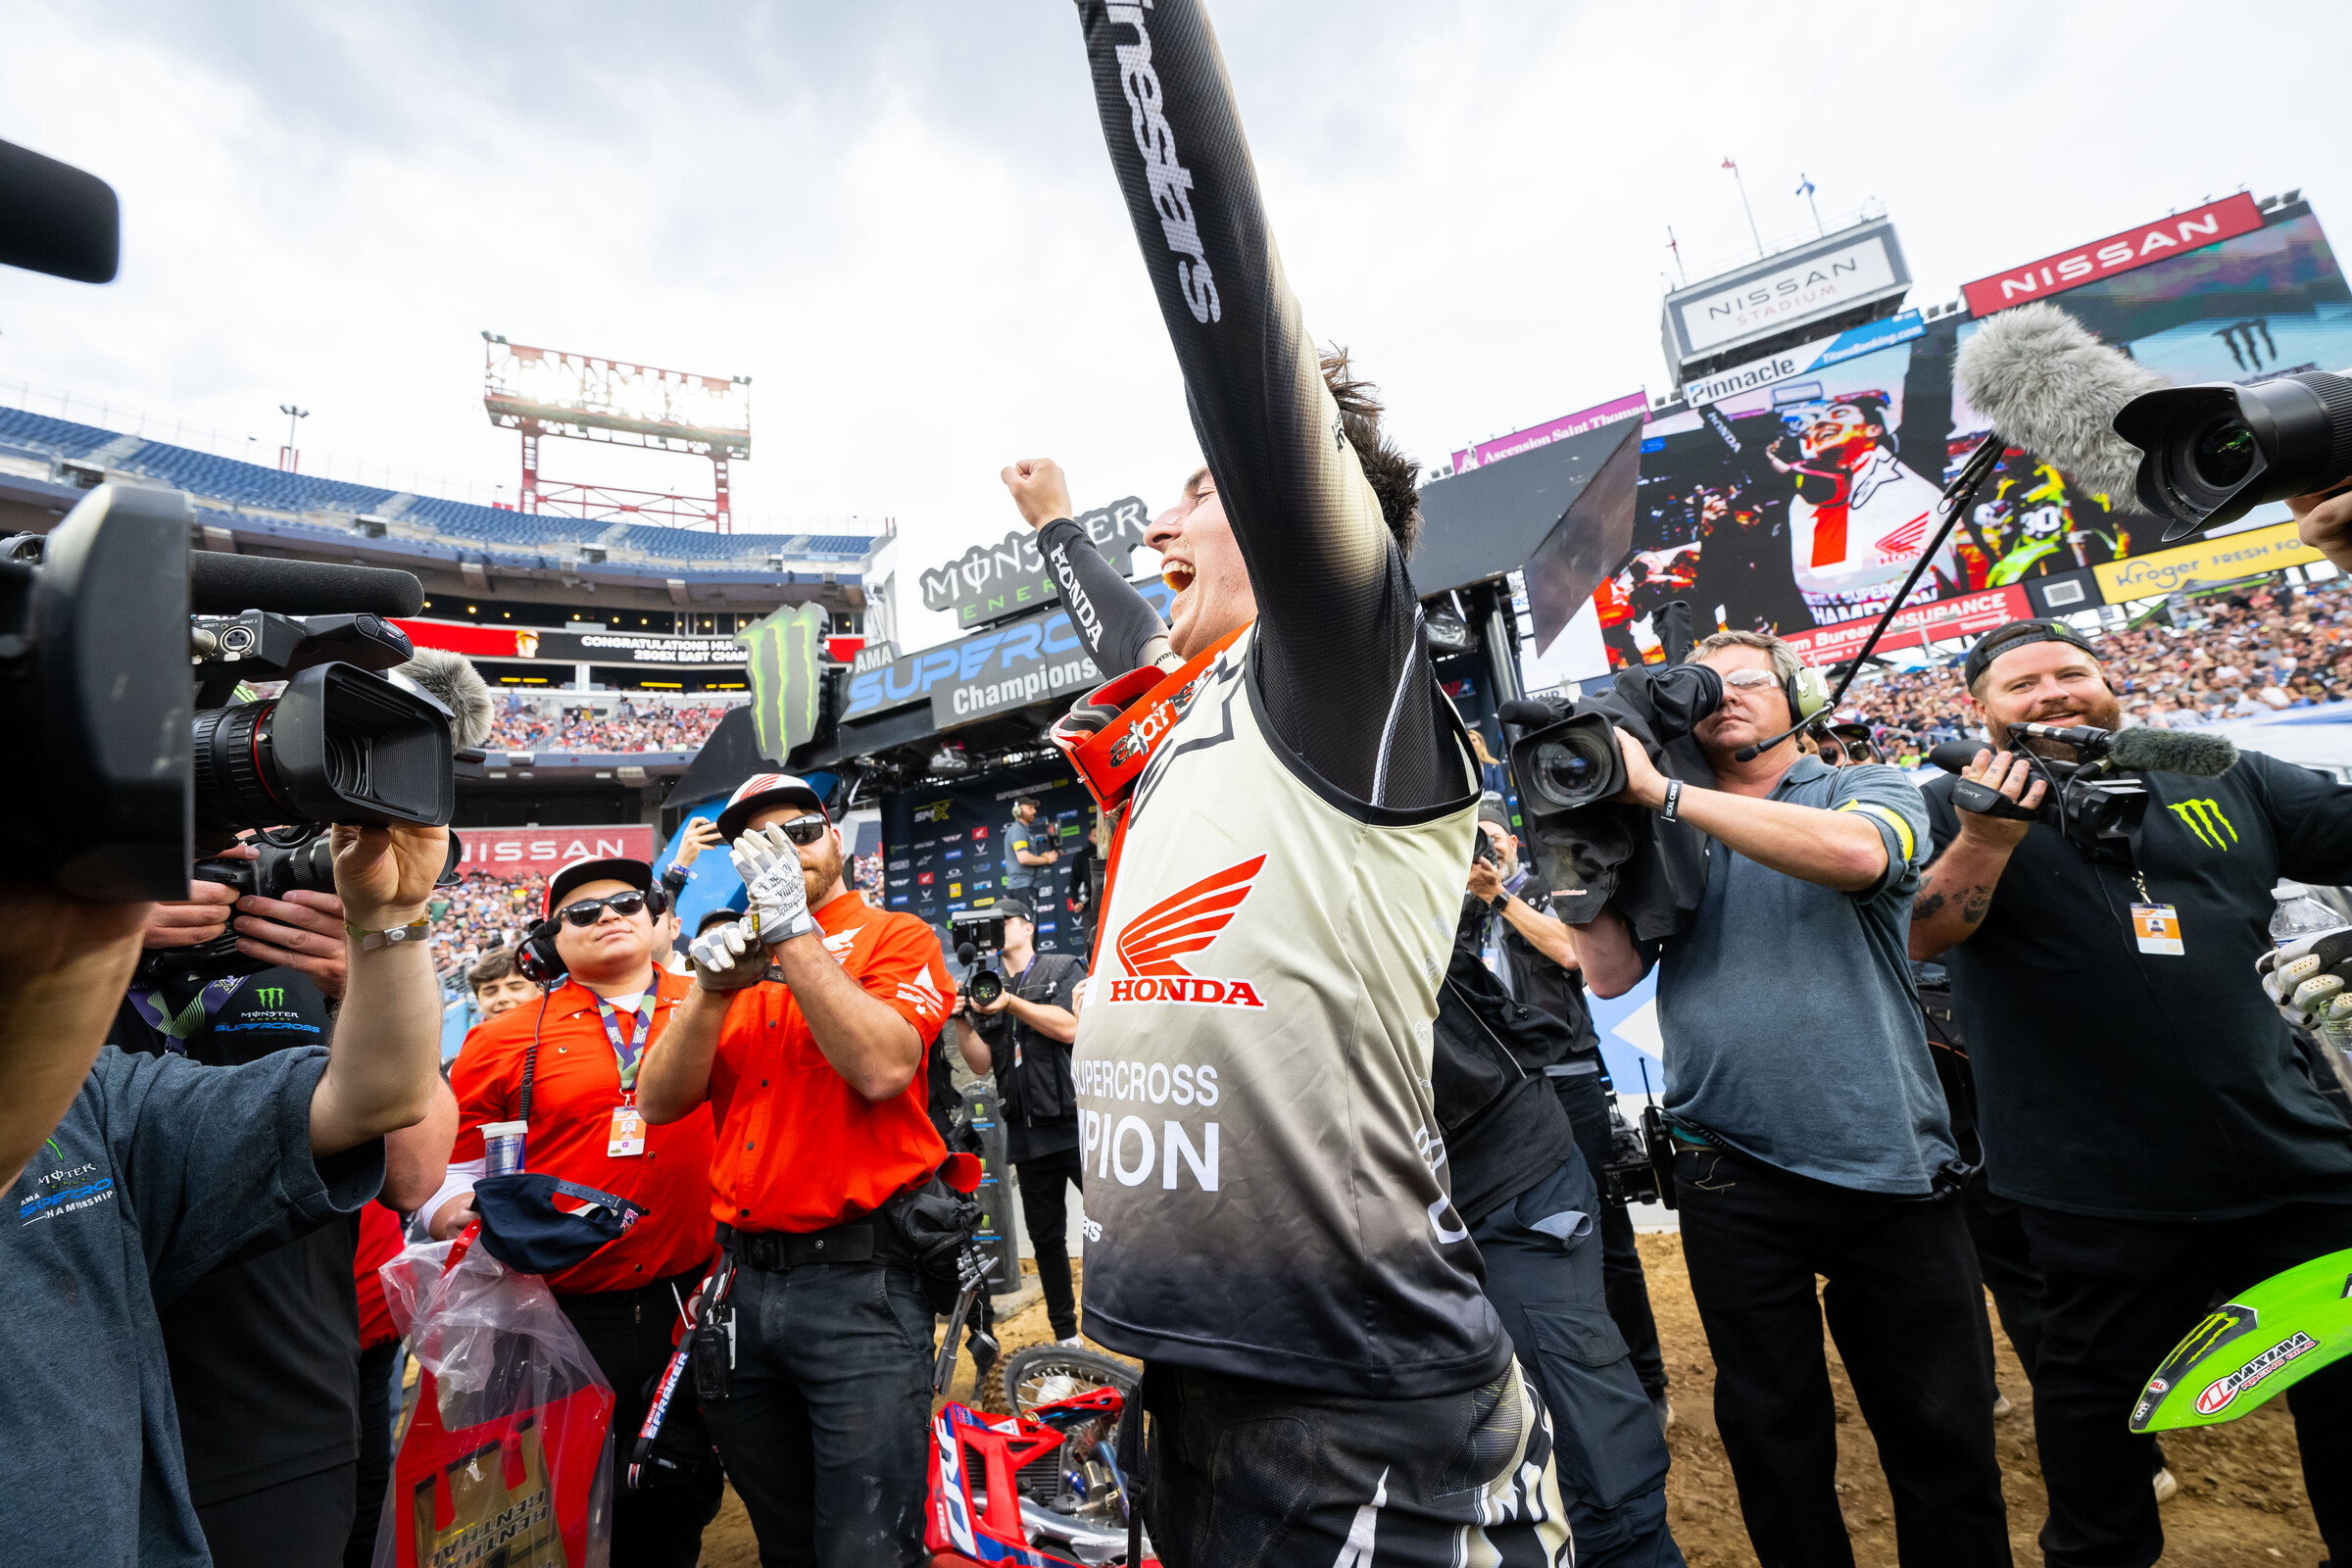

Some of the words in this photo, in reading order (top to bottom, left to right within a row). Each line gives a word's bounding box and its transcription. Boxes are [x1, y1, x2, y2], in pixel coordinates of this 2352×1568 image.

[2000, 212, 2220, 300] NISSAN
[1708, 257, 1858, 321] NISSAN
[1736, 284, 1838, 327] STADIUM
[1689, 357, 1796, 403] Pinnacle
[1484, 434, 1551, 465] Ascension
[1551, 420, 1589, 442] Saint
[1589, 403, 1649, 431] Thomas
[2019, 505, 2062, 534] 30
[924, 500, 1148, 605] MONSER
[1878, 549, 1929, 566] HON
[2115, 559, 2200, 589] Kroger
[2212, 545, 2270, 566] FRESH
[1050, 542, 1105, 654] HONDA
[581, 634, 710, 652] CONGRATULATIONS
[633, 649, 676, 662] 250SX
[677, 651, 710, 662] EAST
[711, 651, 749, 662] CHAM
[855, 646, 894, 674] AMA
[953, 659, 1102, 716] Champions
[913, 801, 952, 823] SMX
[1956, 786, 1982, 799] SONY
[240, 1010, 300, 1019] MONSTER
[1108, 977, 1266, 1008] HONDA
[213, 1022, 320, 1034] SUPERCROSS
[1071, 1059, 1219, 1107] SUPERCROSS
[21, 1192, 40, 1206] AMA
[2226, 1330, 2314, 1392] MAXIMA
[2241, 1357, 2284, 1392] RACING
[2285, 1341, 2316, 1360] OILS
[646, 1351, 690, 1440] SPRAKER
[647, 1401, 659, 1425] MIKE
[426, 1489, 547, 1568] RENTHAL
[445, 1503, 550, 1568] RENTHA
